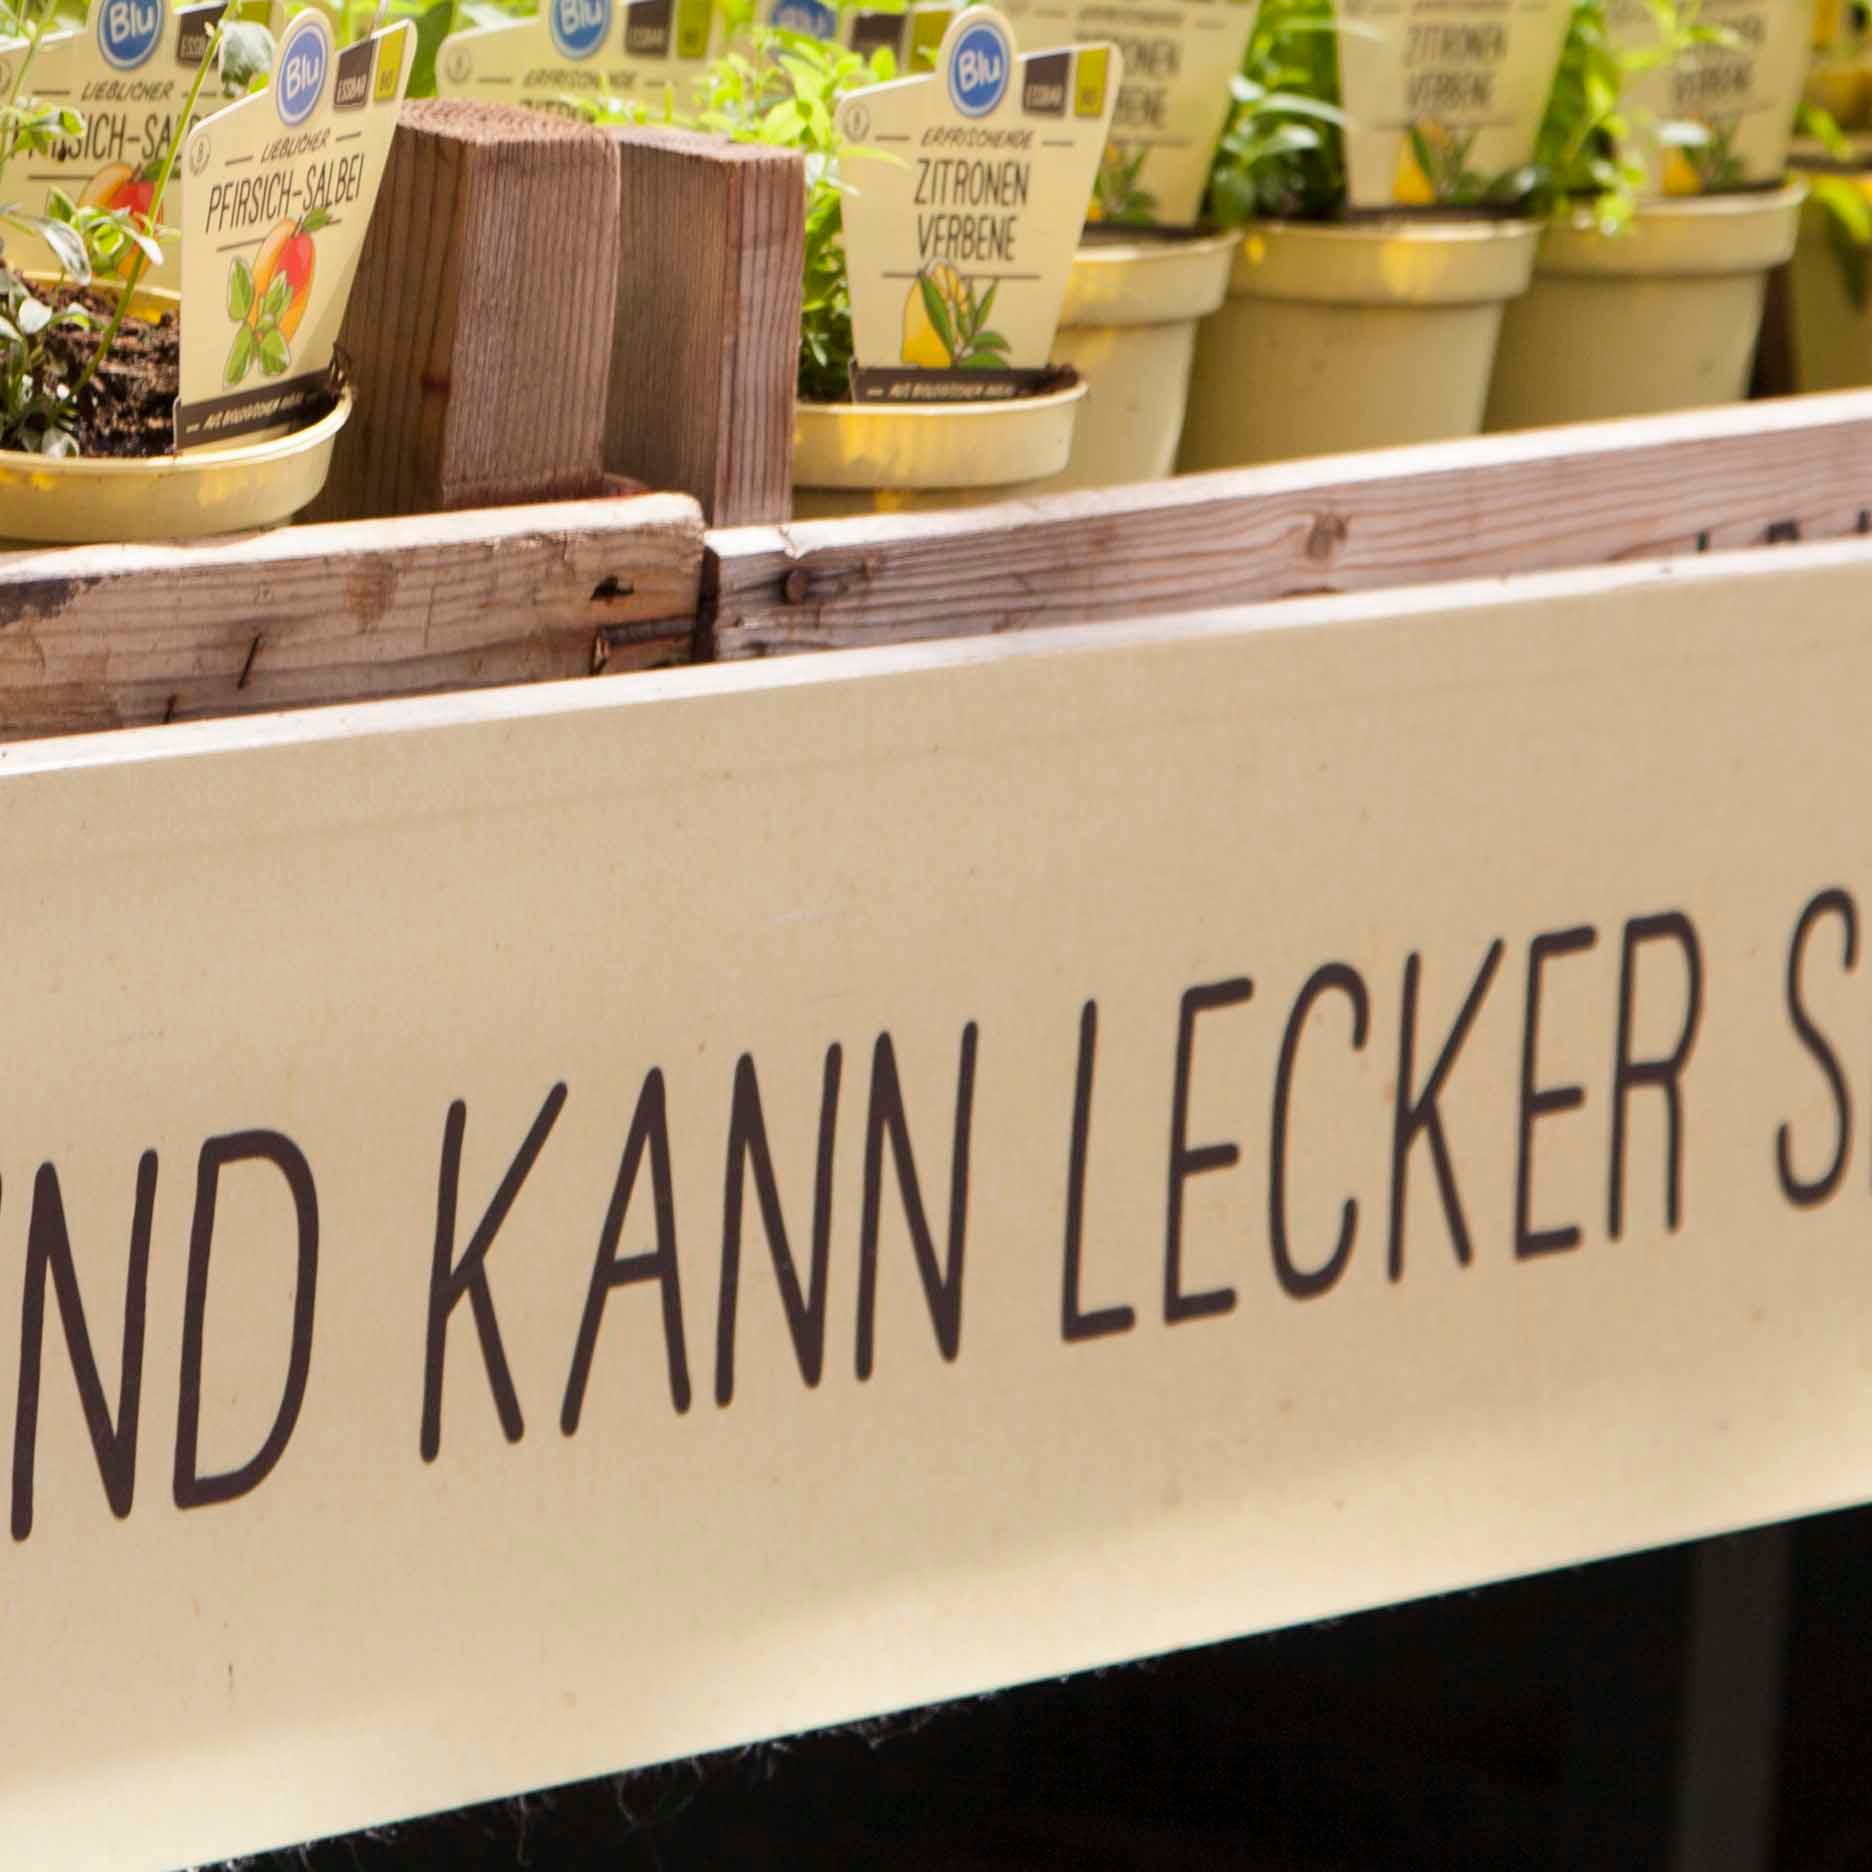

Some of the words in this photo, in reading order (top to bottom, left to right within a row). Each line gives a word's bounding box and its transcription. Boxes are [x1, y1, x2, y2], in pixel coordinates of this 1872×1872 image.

[109, 0, 156, 44] Blu
[81, 80, 174, 101] LIEBLICHER
[286, 53, 319, 101] Blu
[959, 50, 1001, 93] Blu
[260, 128, 331, 163] LIEBLICHER
[205, 151, 366, 235] PFIRSICH-SALBEI
[914, 158, 1030, 207] ZITRONEN
[917, 214, 1017, 262] VERBENE
[419, 1020, 981, 1464] KANN
[1061, 909, 1706, 1344] LECKER
